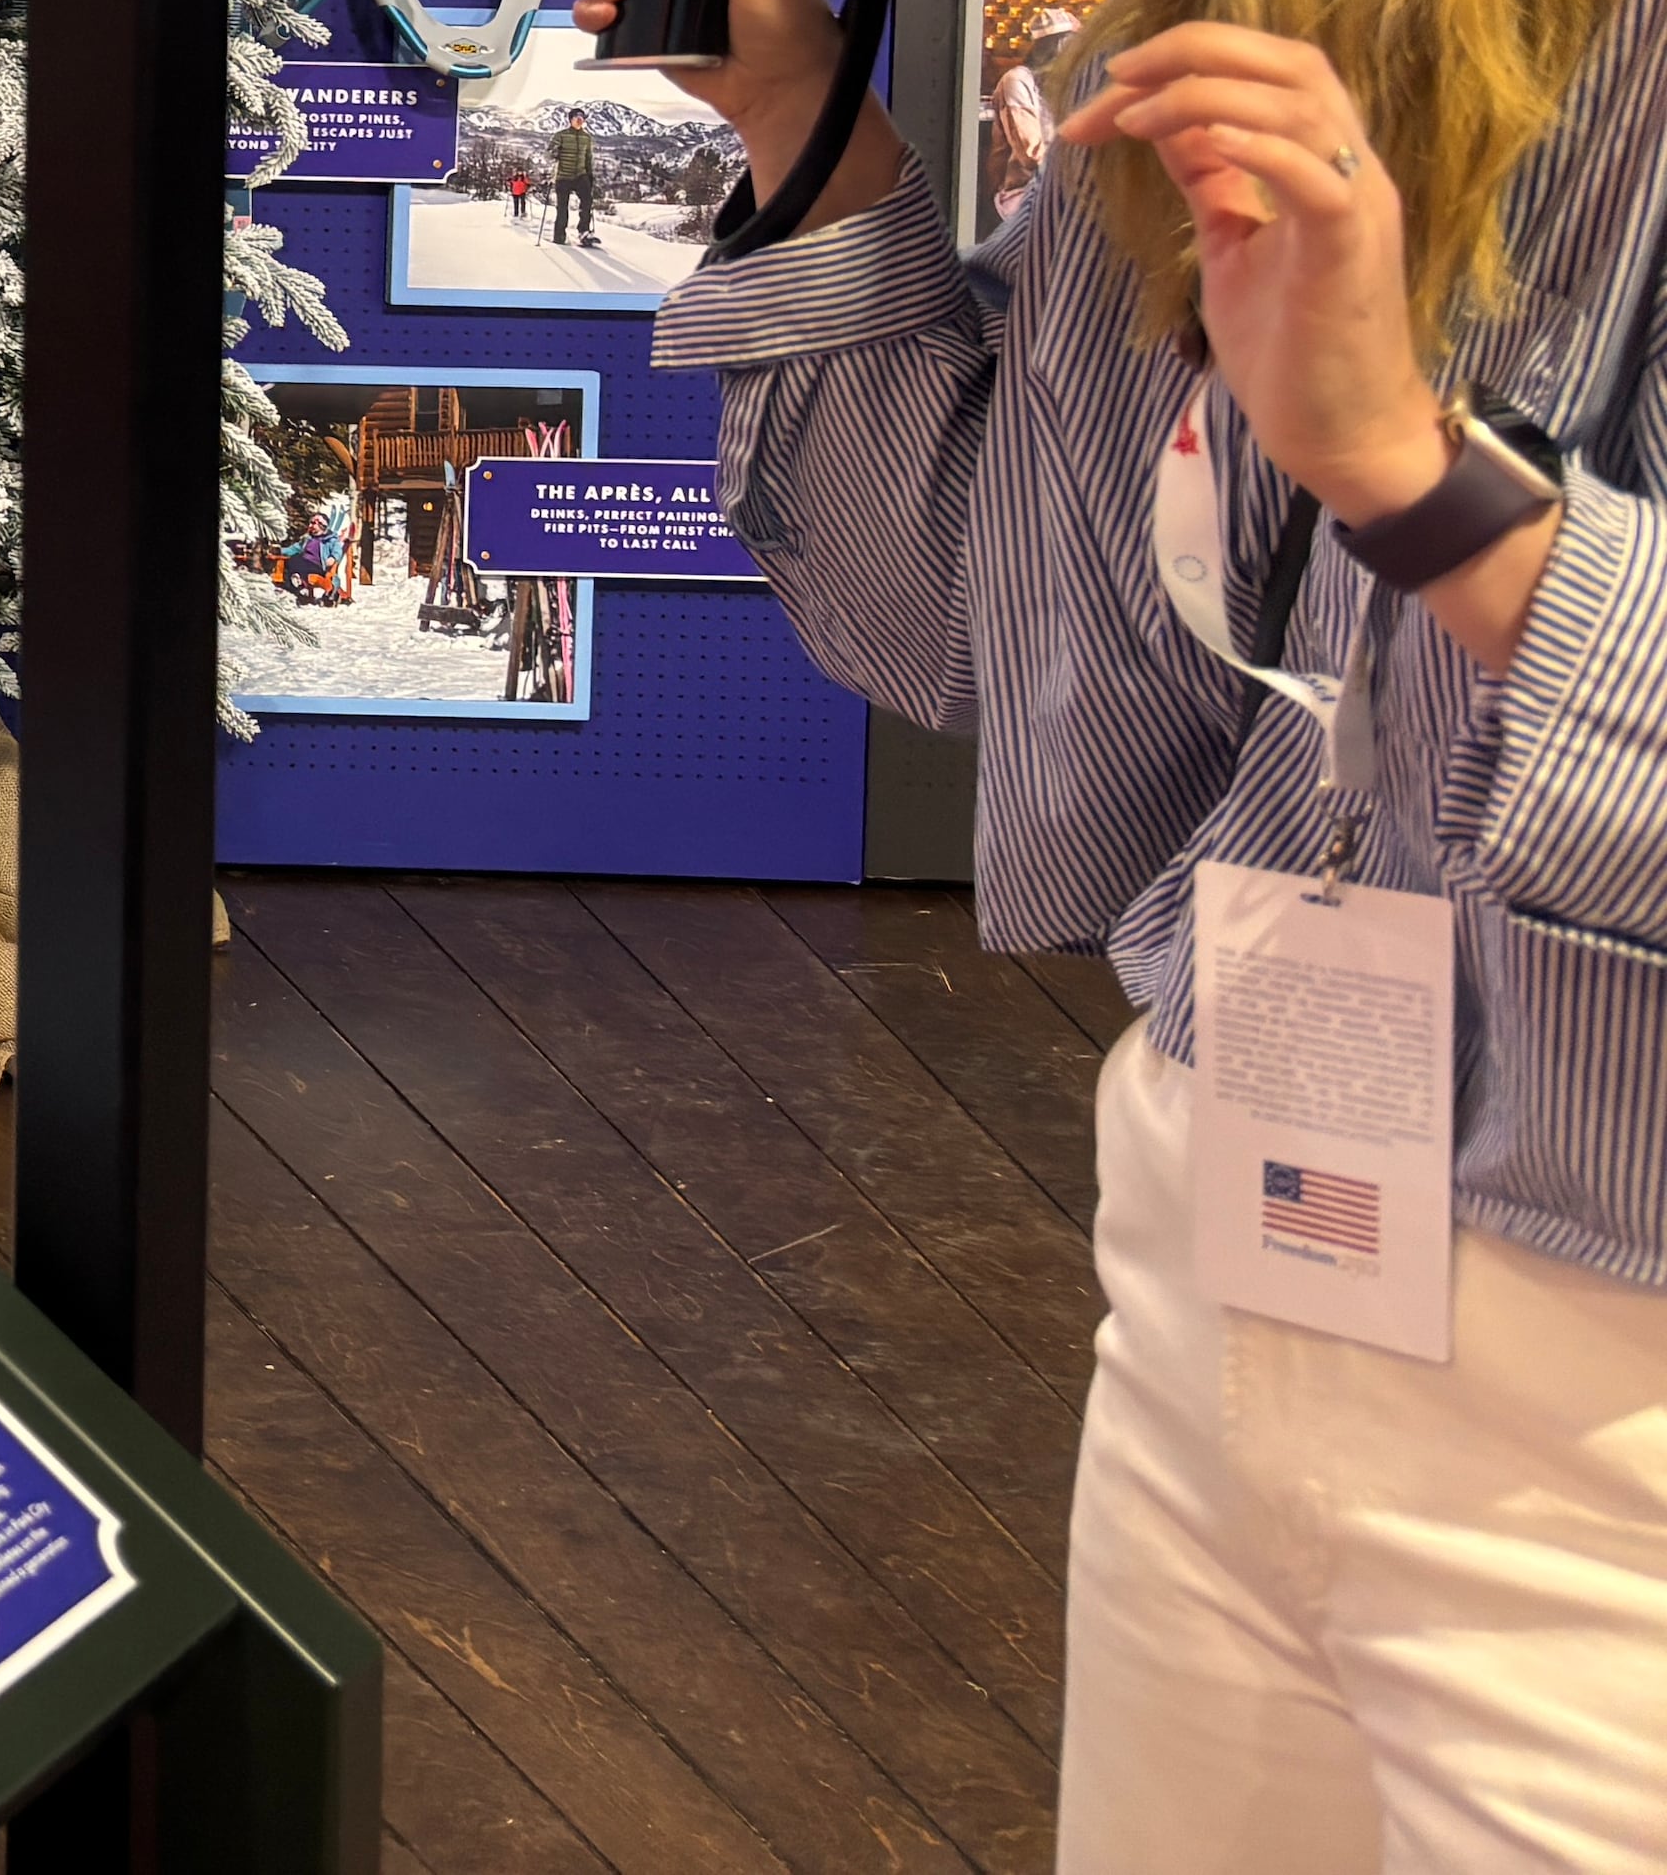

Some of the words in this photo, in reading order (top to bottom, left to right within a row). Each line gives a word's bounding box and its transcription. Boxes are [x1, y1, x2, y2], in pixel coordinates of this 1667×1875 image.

[358, 114, 405, 126] PINES,
[312, 128, 373, 139] ESCAPES
[378, 129, 414, 140] JUST
[536, 485, 576, 501] THE
[584, 483, 663, 504] APRÈS,
[670, 487, 711, 503] ALL
[530, 508, 590, 522] DRINKS,
[594, 509, 653, 521] PERFECT
[657, 511, 727, 523] PAIRINGS
[544, 523, 575, 533] FIRE
[664, 525, 704, 537] FIRST
[599, 538, 618, 549] TO
[622, 539, 658, 550] LAST
[662, 540, 698, 551] CALL
